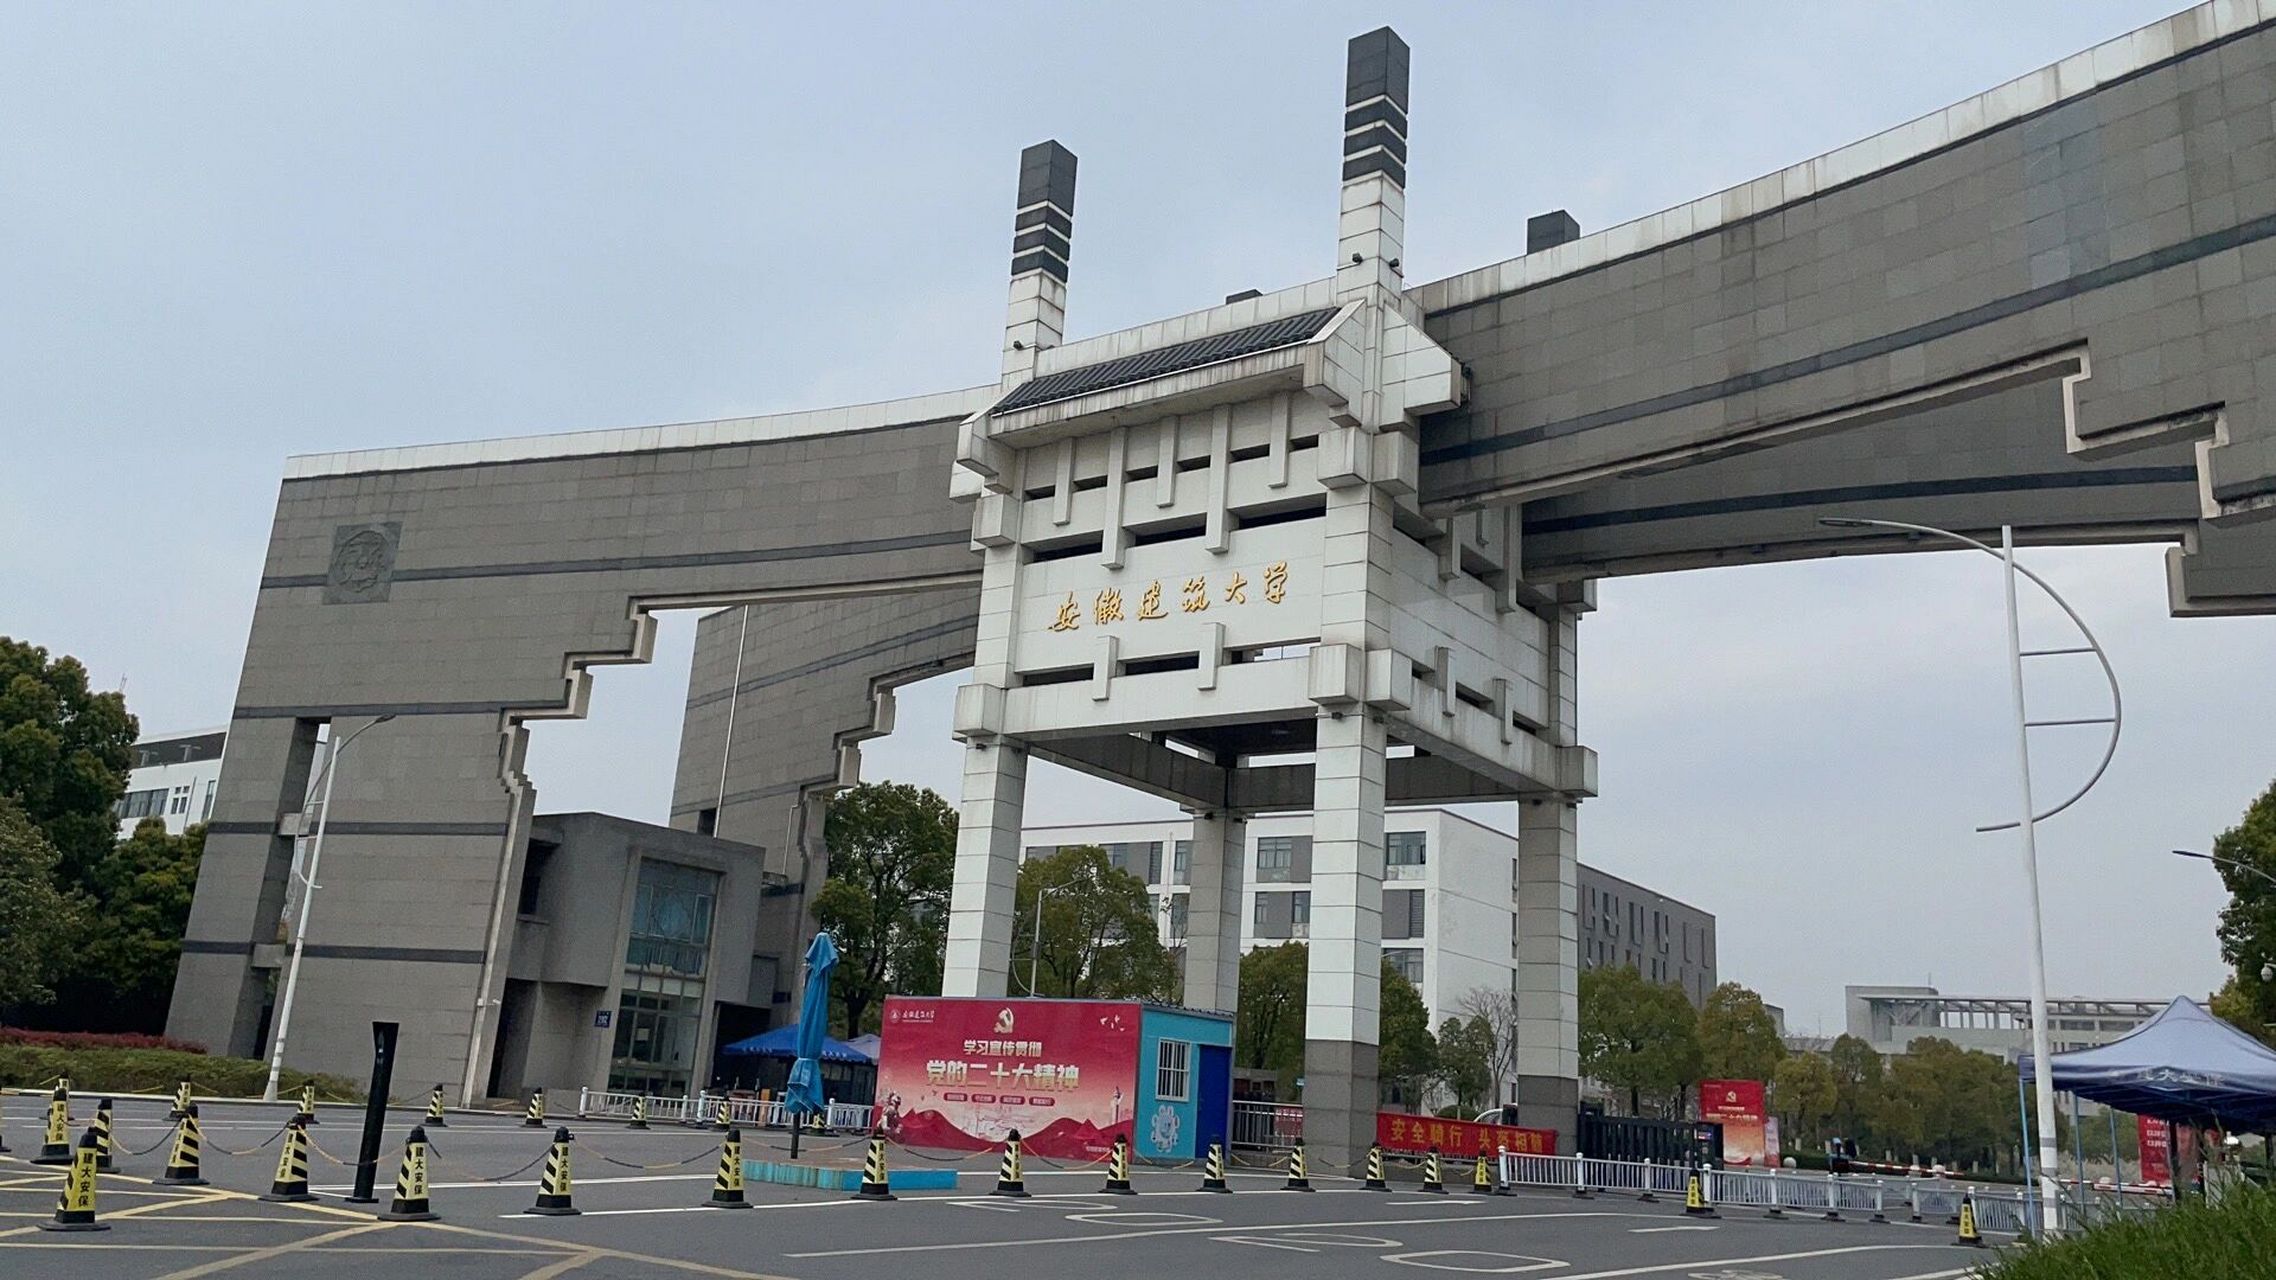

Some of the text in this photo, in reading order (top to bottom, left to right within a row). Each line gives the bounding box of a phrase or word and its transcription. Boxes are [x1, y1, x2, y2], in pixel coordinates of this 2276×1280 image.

[1047, 560, 1288, 632] 安徽建筑大学
[964, 1039, 1042, 1057] 学习宣传贯彻
[926, 1060, 1079, 1091] 党的二十大精神
[1391, 1119, 1462, 1147] 安全骑行
[79, 1153, 93, 1207] 建大安保
[414, 1146, 424, 1195] 建大安保
[560, 1146, 569, 1192] 建大安保
